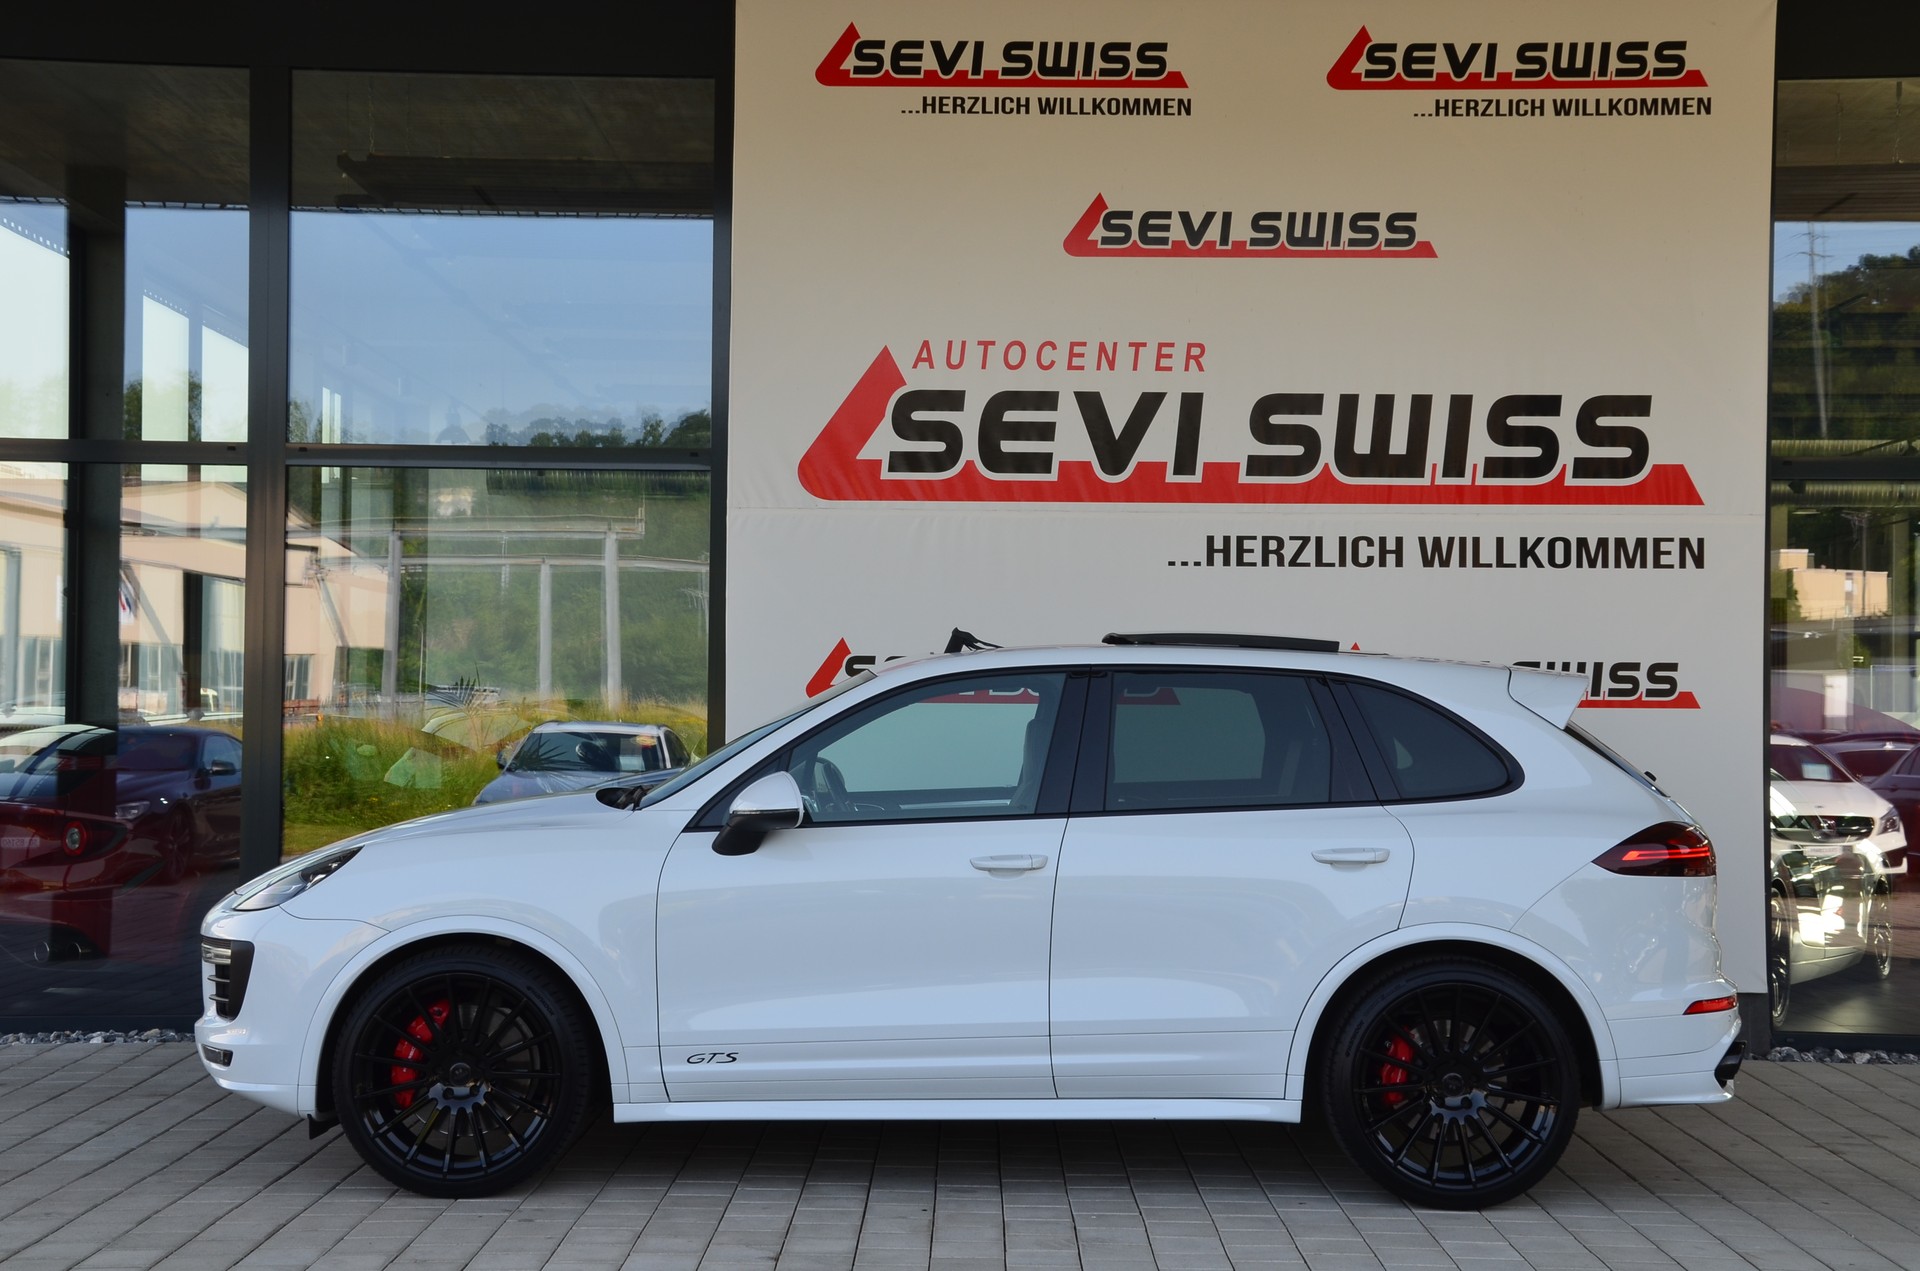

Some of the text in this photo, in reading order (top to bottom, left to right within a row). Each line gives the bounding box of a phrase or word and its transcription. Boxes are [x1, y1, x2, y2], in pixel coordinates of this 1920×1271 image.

[853, 40, 1167, 77] SEVI SWISS
[1365, 41, 1686, 78] SEVI SWISS
[1038, 98, 1191, 115] WILLKOMMEN
[1553, 98, 1711, 116] WILLKOMMEN
[1101, 211, 1416, 247] SEVI SWISS
[913, 340, 1205, 371] AUTOCENTER
[888, 390, 1651, 478] SEVI SWISS
[1419, 537, 1704, 568] WILLKOMMEN
[1513, 661, 1679, 698] ISS
[686, 1052, 739, 1065] GTS
